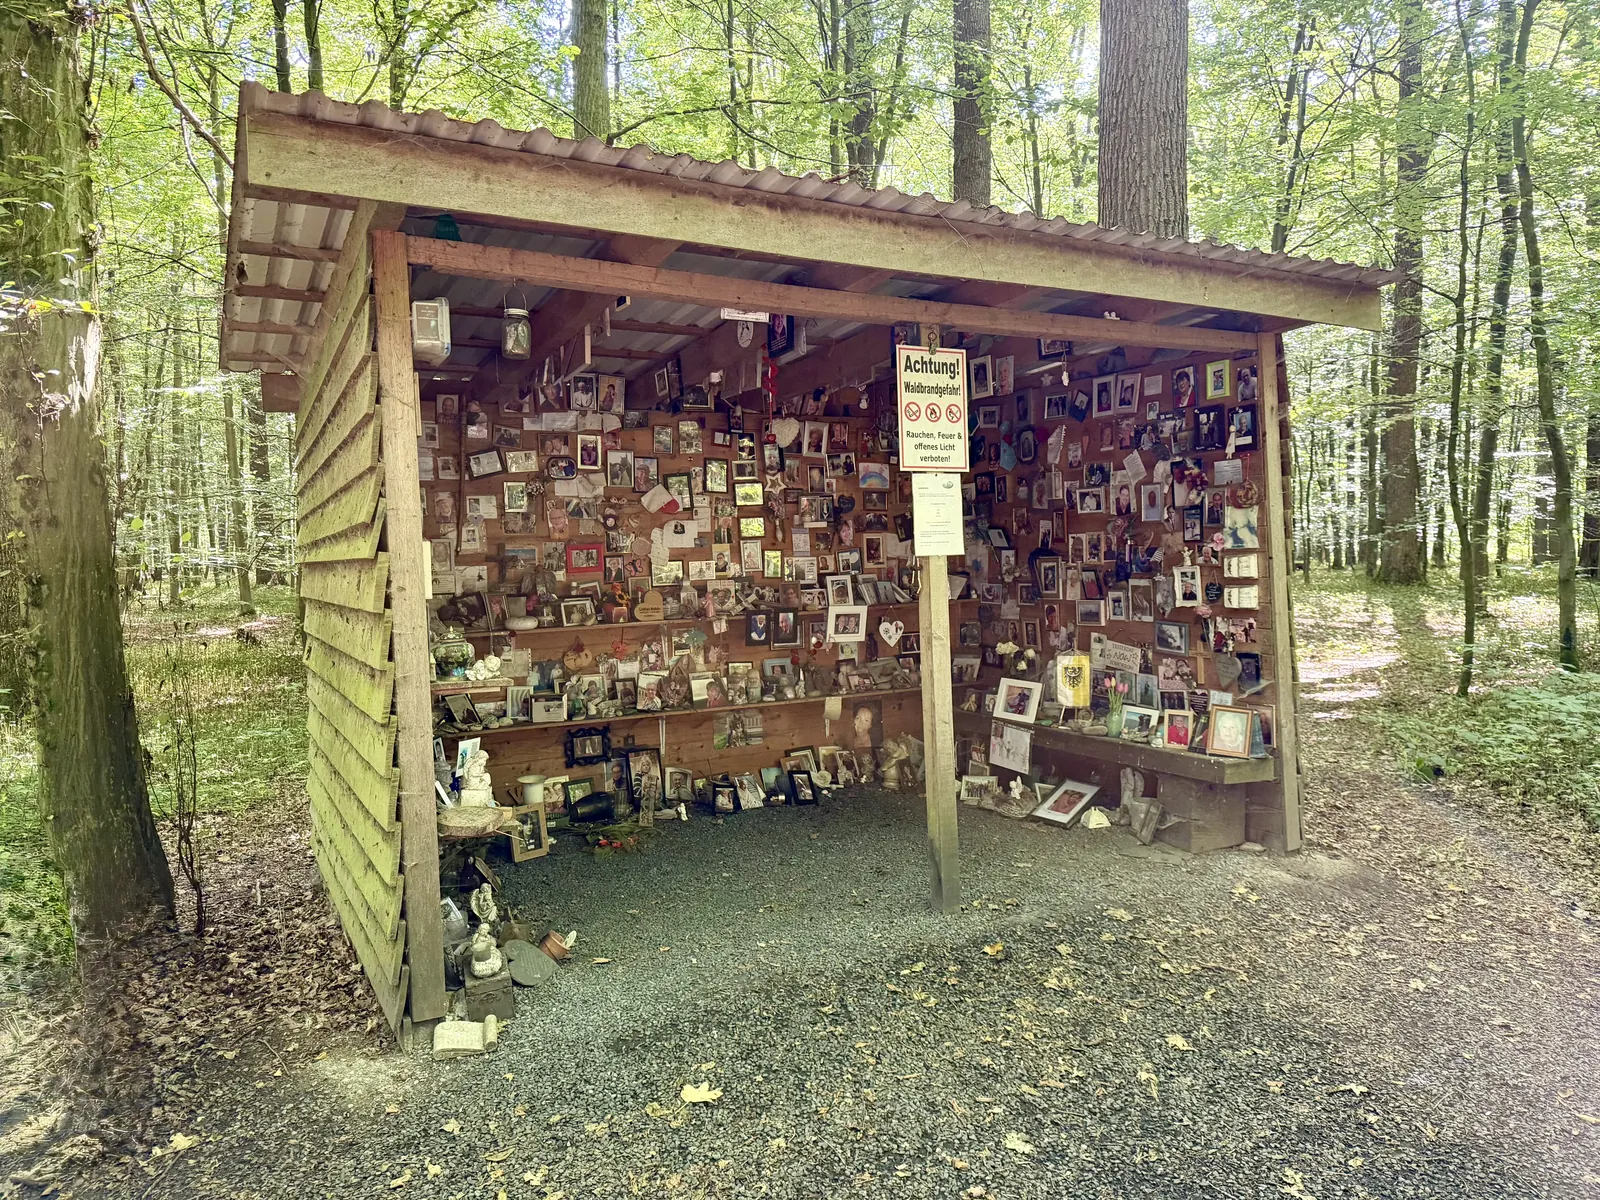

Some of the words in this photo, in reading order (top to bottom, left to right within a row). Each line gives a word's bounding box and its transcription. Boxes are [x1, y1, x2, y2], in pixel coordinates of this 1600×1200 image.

[904, 355, 960, 380] Achtung!
[904, 381, 961, 398] Waldbrandgefahr!
[906, 431, 936, 440] Rauchen,
[938, 432, 956, 440] Feuer
[914, 443, 939, 451] offenes
[940, 443, 956, 451] Licht
